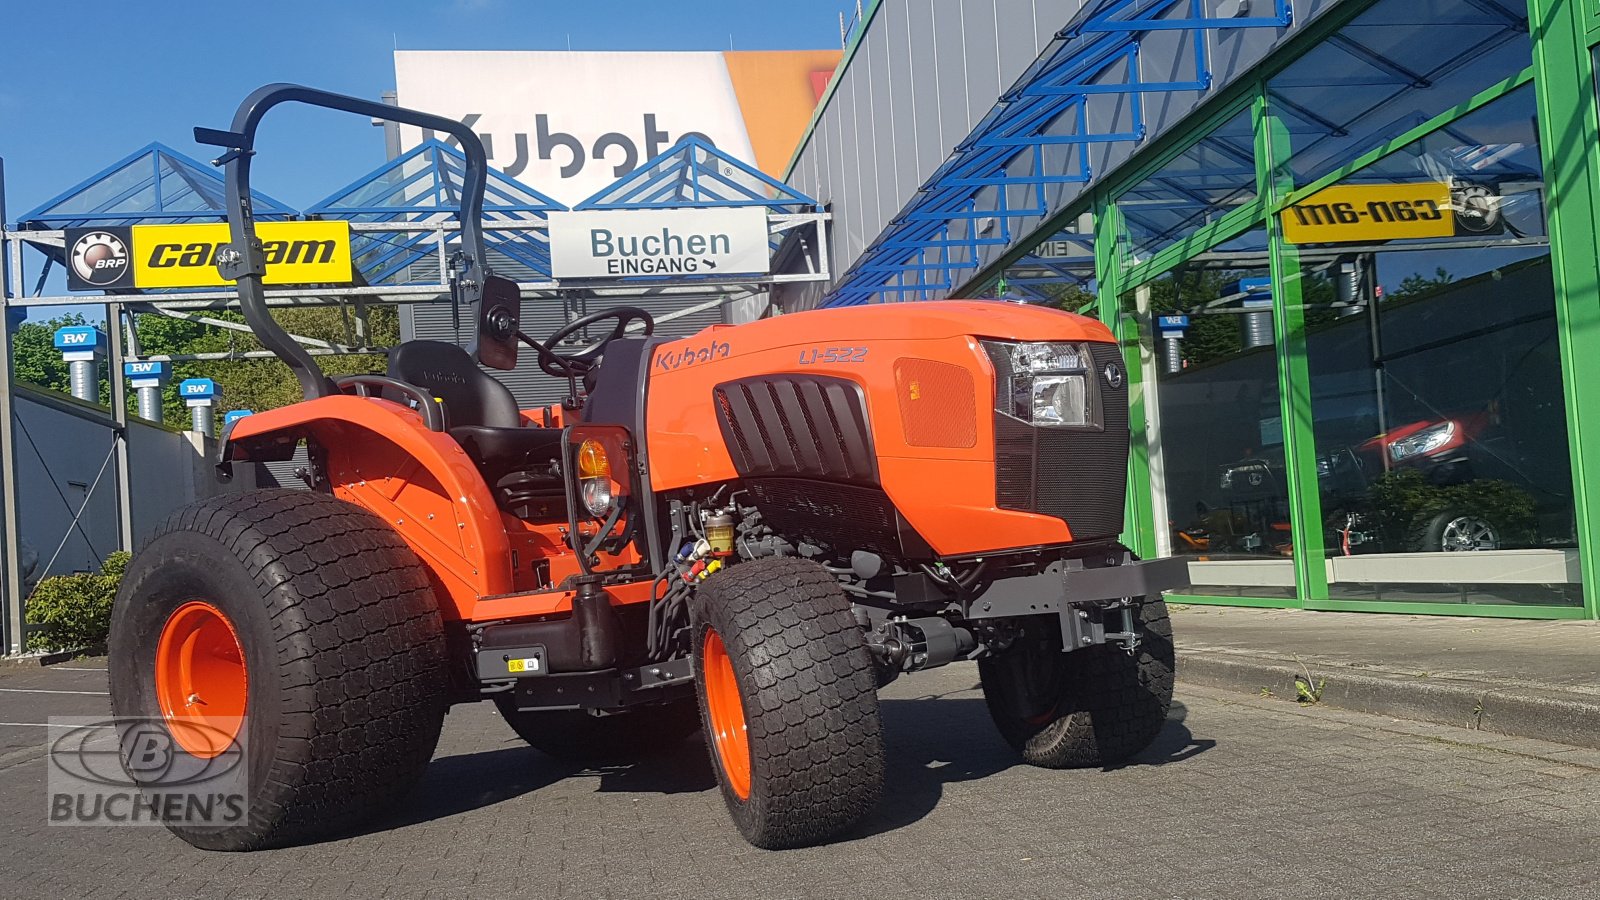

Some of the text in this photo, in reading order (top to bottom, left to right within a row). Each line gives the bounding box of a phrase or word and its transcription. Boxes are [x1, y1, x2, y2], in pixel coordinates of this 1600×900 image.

[591, 227, 731, 257] Buchen
[95, 258, 126, 269] BRP
[607, 257, 698, 274] EINGANG
[655, 340, 731, 371] Kubota
